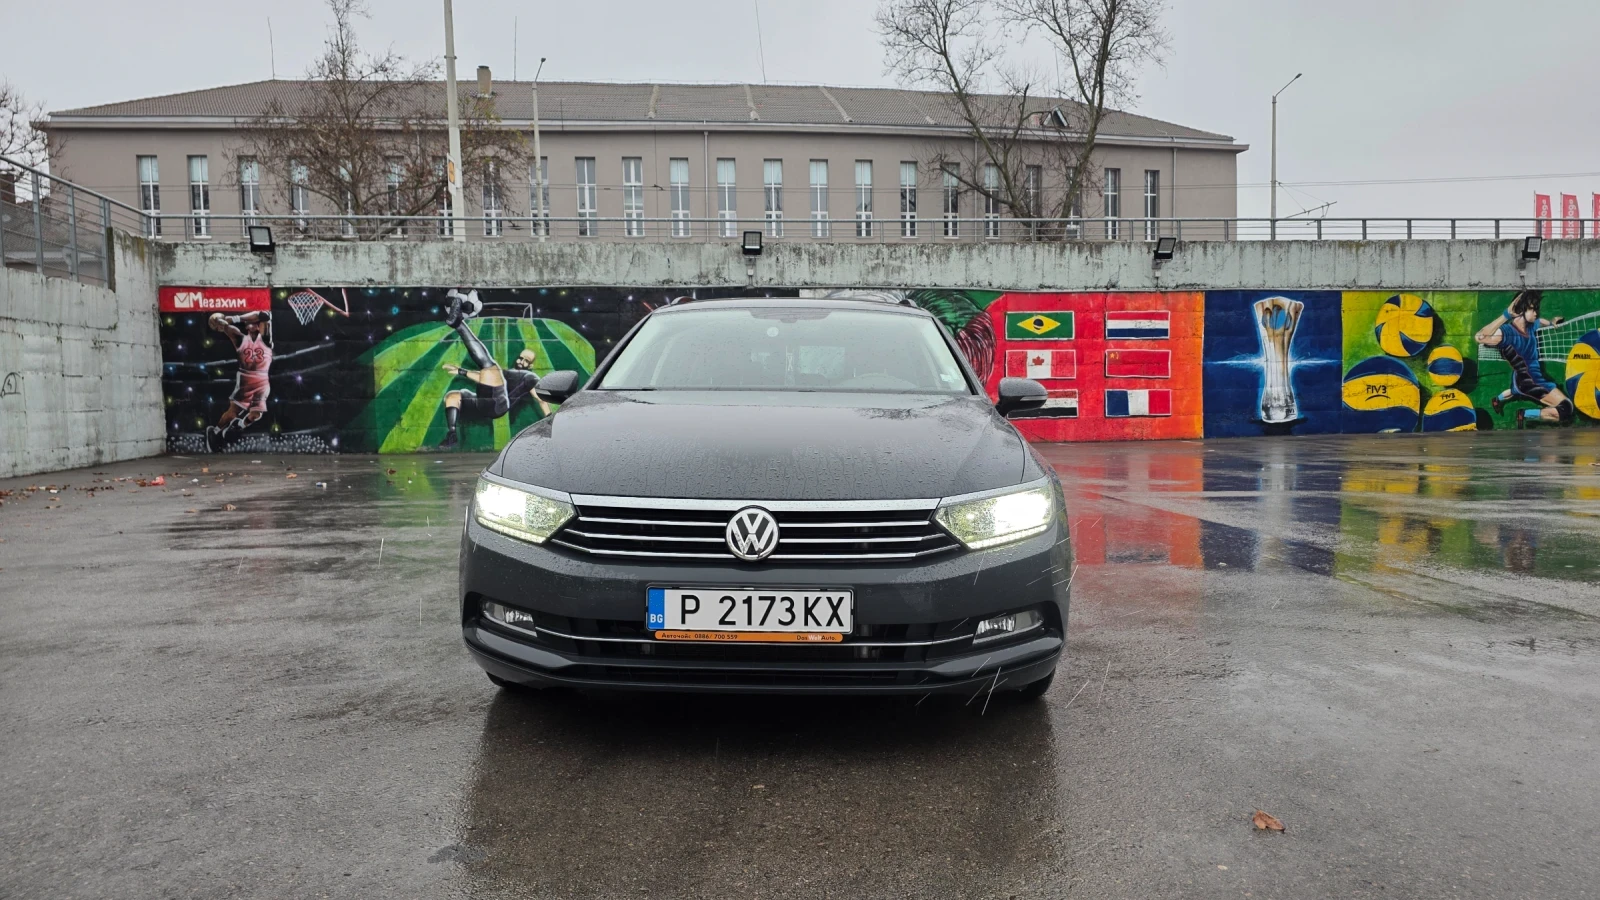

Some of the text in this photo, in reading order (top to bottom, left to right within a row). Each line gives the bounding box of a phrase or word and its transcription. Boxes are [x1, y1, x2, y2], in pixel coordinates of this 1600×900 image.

[190, 292, 246, 308] Мегахим
[243, 348, 264, 363] 23
[727, 508, 778, 560] VW
[650, 614, 664, 623] BG
